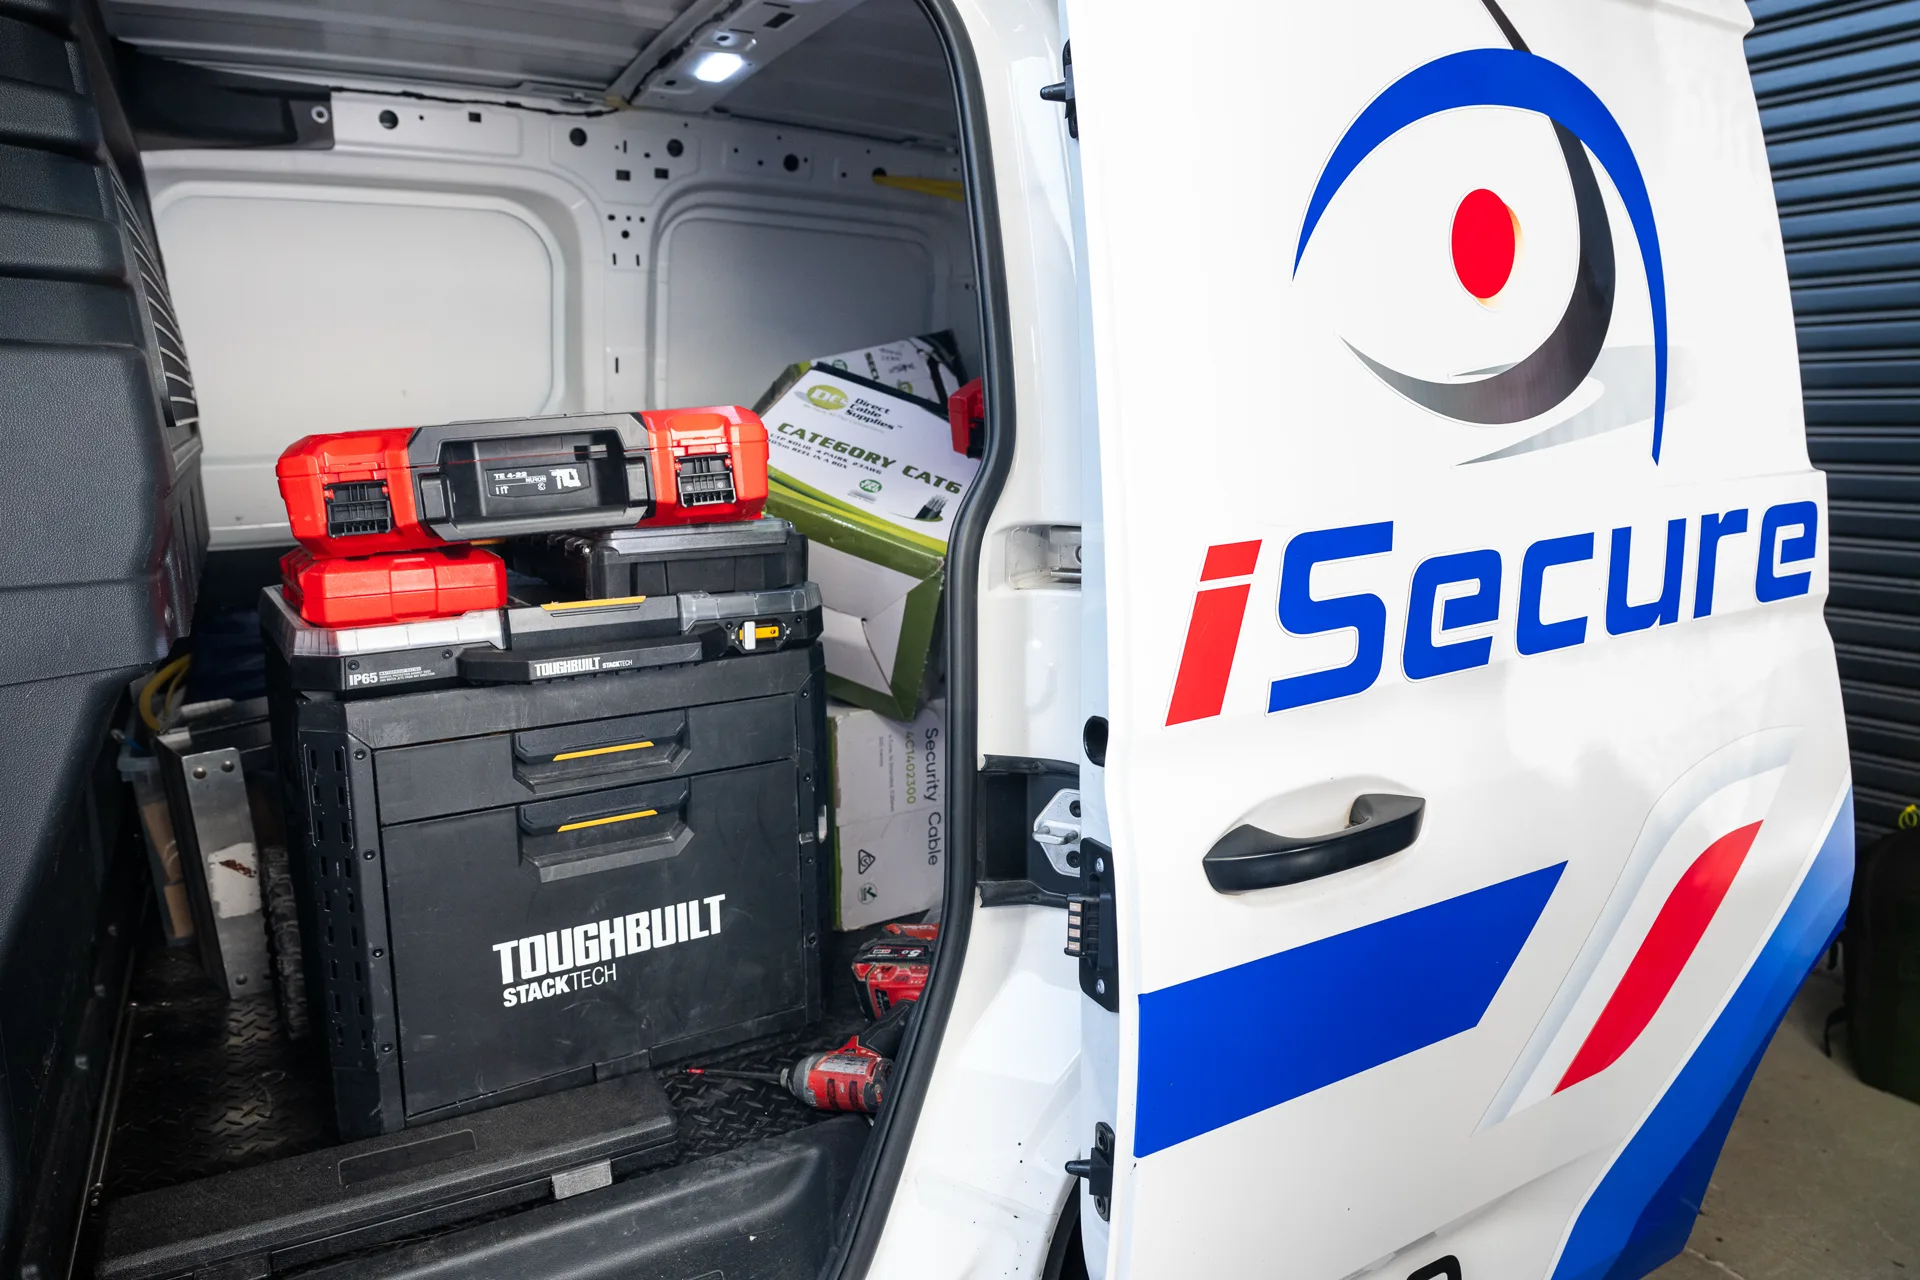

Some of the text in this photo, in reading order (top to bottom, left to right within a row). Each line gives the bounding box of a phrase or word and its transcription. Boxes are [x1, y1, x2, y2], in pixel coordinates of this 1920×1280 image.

[850, 403, 882, 418] Cable
[855, 398, 890, 414] Direct
[846, 409, 894, 430] Supplies
[777, 422, 963, 494] CATEGORY CAT6
[792, 447, 810, 457] REEL
[831, 460, 848, 469] BOX
[852, 462, 882, 475] 23AWG
[507, 471, 528, 479] 4-22
[1165, 500, 1818, 727] iSecure
[535, 657, 632, 677] TOUGHBUILT STACKTECH
[349, 672, 378, 686] IP65
[905, 731, 916, 804] 4C1402300
[924, 728, 941, 866] Security Cable
[492, 894, 726, 985] TOUGHBUILT
[503, 963, 617, 1008] STACKTECH
